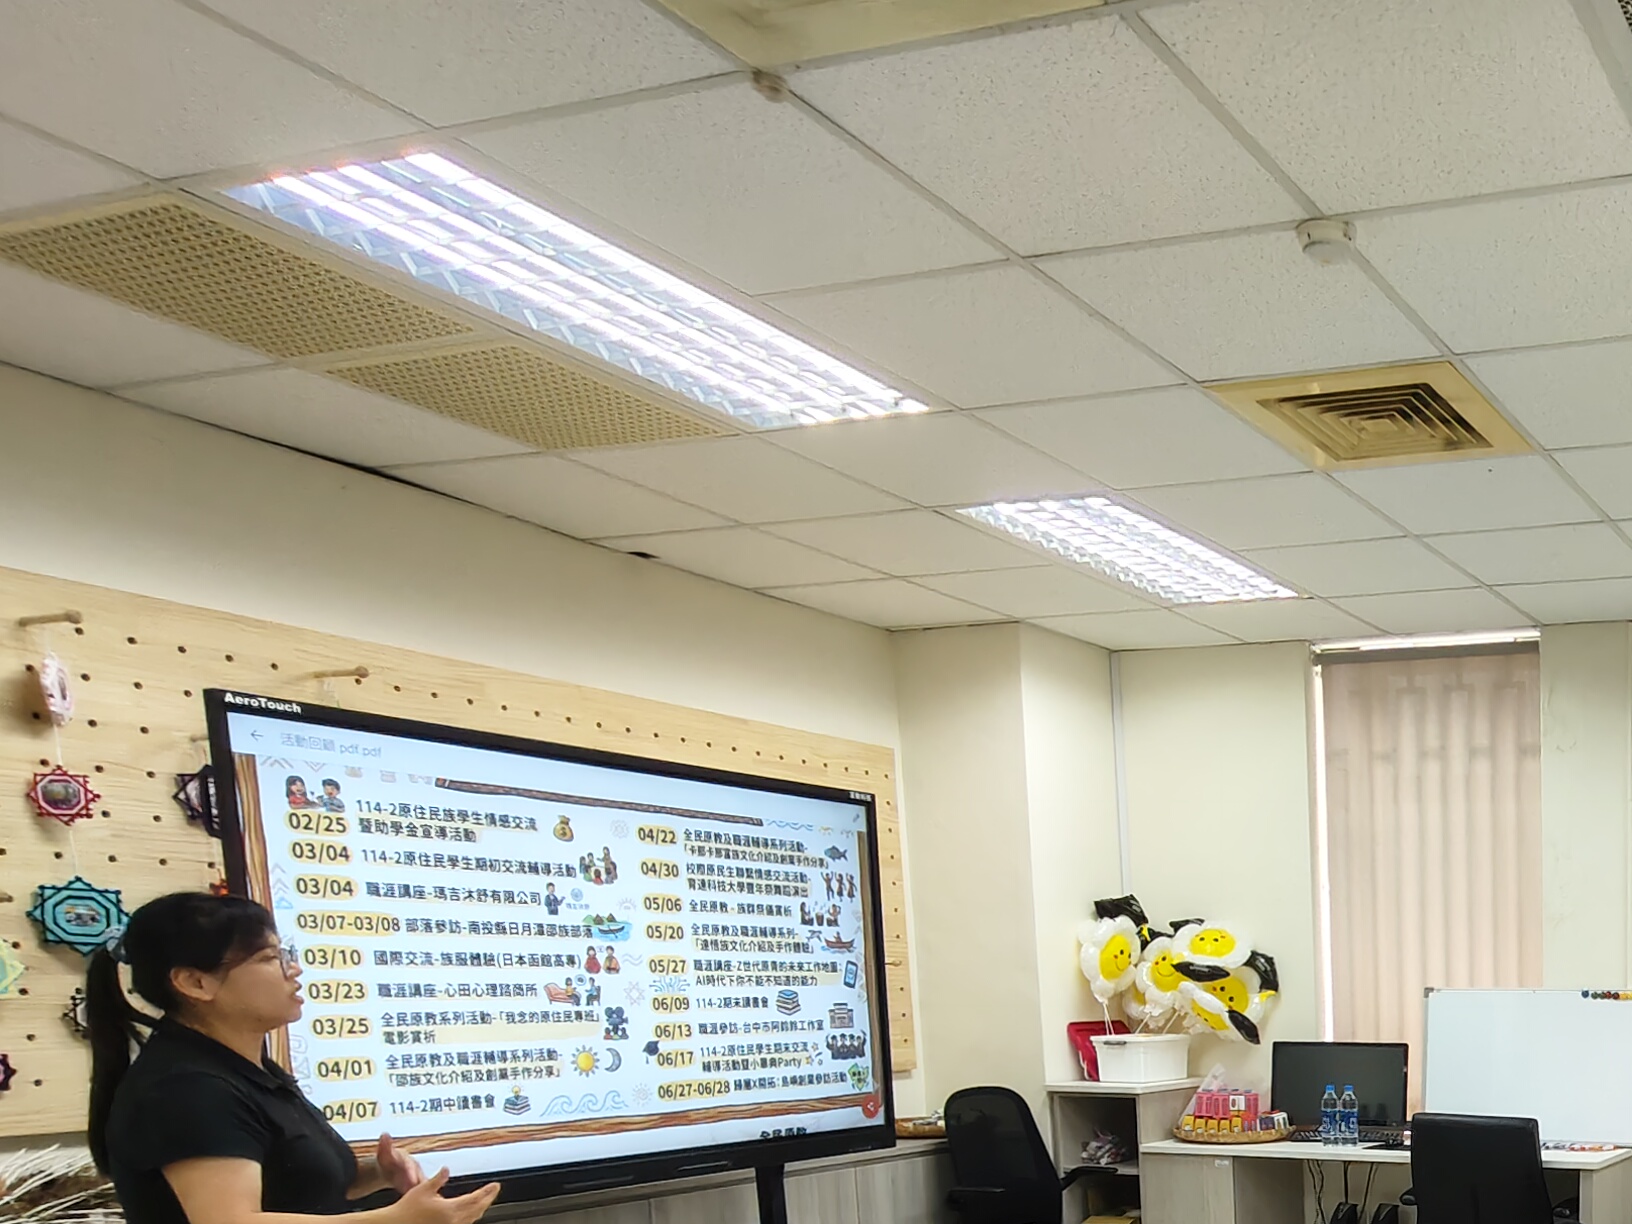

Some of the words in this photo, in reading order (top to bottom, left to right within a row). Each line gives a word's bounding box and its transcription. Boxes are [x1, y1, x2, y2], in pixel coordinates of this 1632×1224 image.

[224, 692, 302, 715] AeroTouch
[288, 811, 347, 834] 02/25
[637, 826, 677, 845] 04/22
[292, 841, 350, 863] 03/04
[640, 861, 679, 878] 04/30
[296, 877, 354, 898] 03/04
[643, 896, 682, 913] 05/06
[297, 913, 401, 933] 03/07-03/08
[646, 925, 684, 940] 05/20
[304, 947, 361, 967] 03/10
[648, 959, 686, 974] 05/27
[308, 981, 365, 1000] 03/23
[652, 995, 690, 1010] 06/09
[312, 1015, 370, 1036] 03/25
[654, 1022, 692, 1038] 06/13
[382, 1031, 436, 1045] 電影賞析
[317, 1057, 373, 1078] 04/01
[656, 1051, 694, 1066] 06/17
[658, 1080, 731, 1100] 06/27-06/28
[324, 1100, 377, 1121] 04/07
